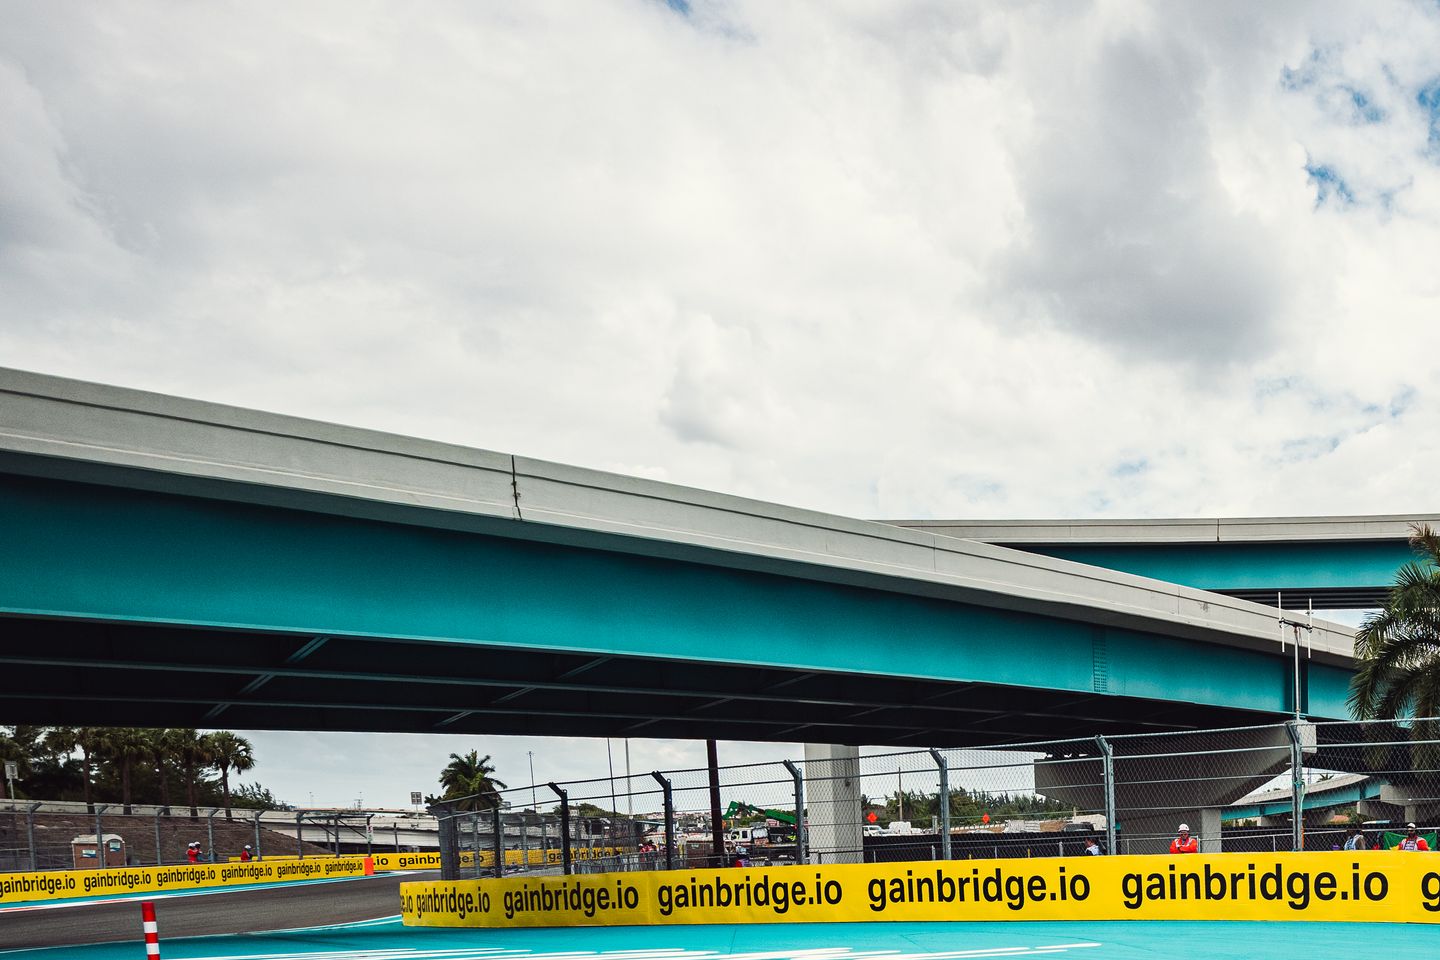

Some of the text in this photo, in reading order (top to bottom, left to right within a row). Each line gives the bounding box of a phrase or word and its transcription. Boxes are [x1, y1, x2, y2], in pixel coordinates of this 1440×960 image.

[84, 870, 151, 892] gainbridge.io
[156, 866, 216, 886] gainbridge.io
[221, 864, 273, 881] gainbridge.io
[277, 860, 321, 878] gainbridge.io
[324, 858, 363, 875] gainbridge.io
[416, 886, 490, 919] gainbridge.io
[503, 879, 639, 919] gainbridge.io
[658, 872, 843, 916] gainbridge.io
[867, 866, 1091, 912] gainbridge.io
[1121, 863, 1389, 911] gainbridge.io
